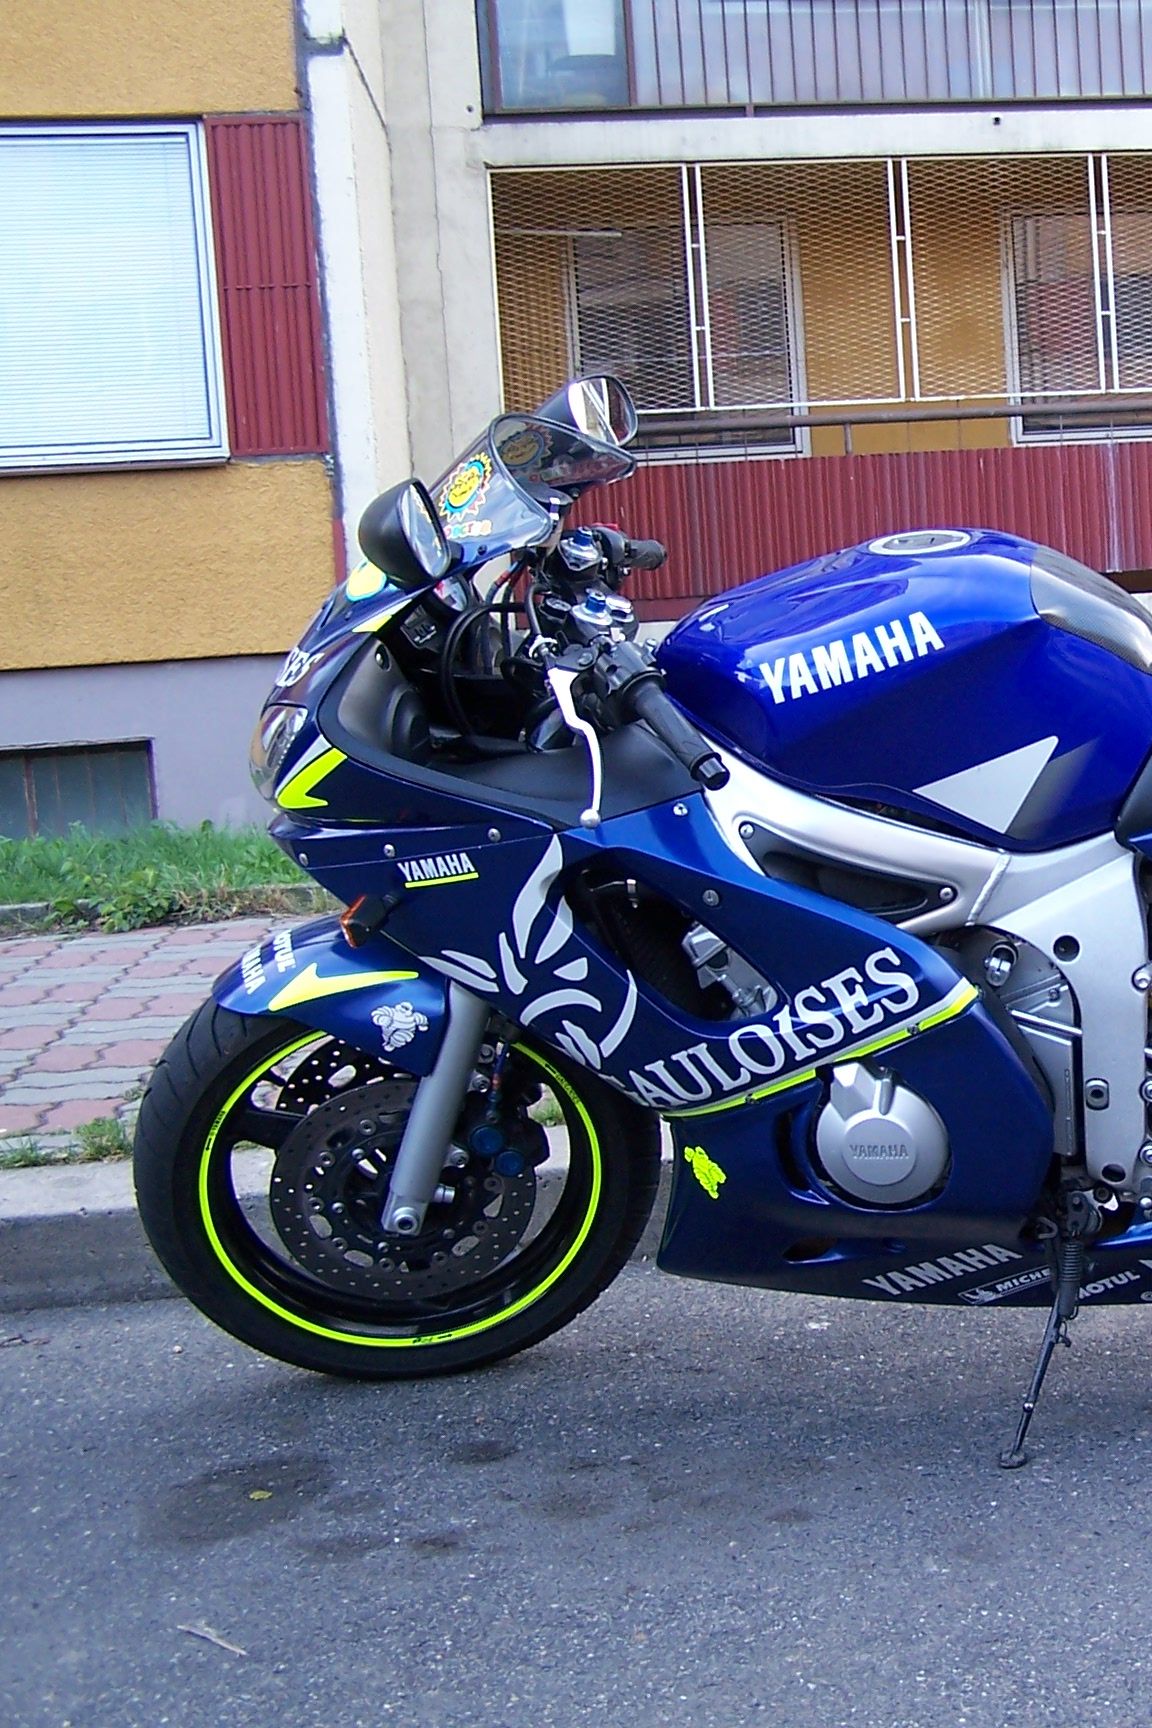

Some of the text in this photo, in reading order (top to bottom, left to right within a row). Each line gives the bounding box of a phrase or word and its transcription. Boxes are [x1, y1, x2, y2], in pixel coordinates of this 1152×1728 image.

[759, 611, 945, 704] YAMAHA
[397, 852, 476, 882] YAMAHA
[849, 1144, 908, 1158] YAMAHA
[862, 1244, 1023, 1296] YAMAHA
